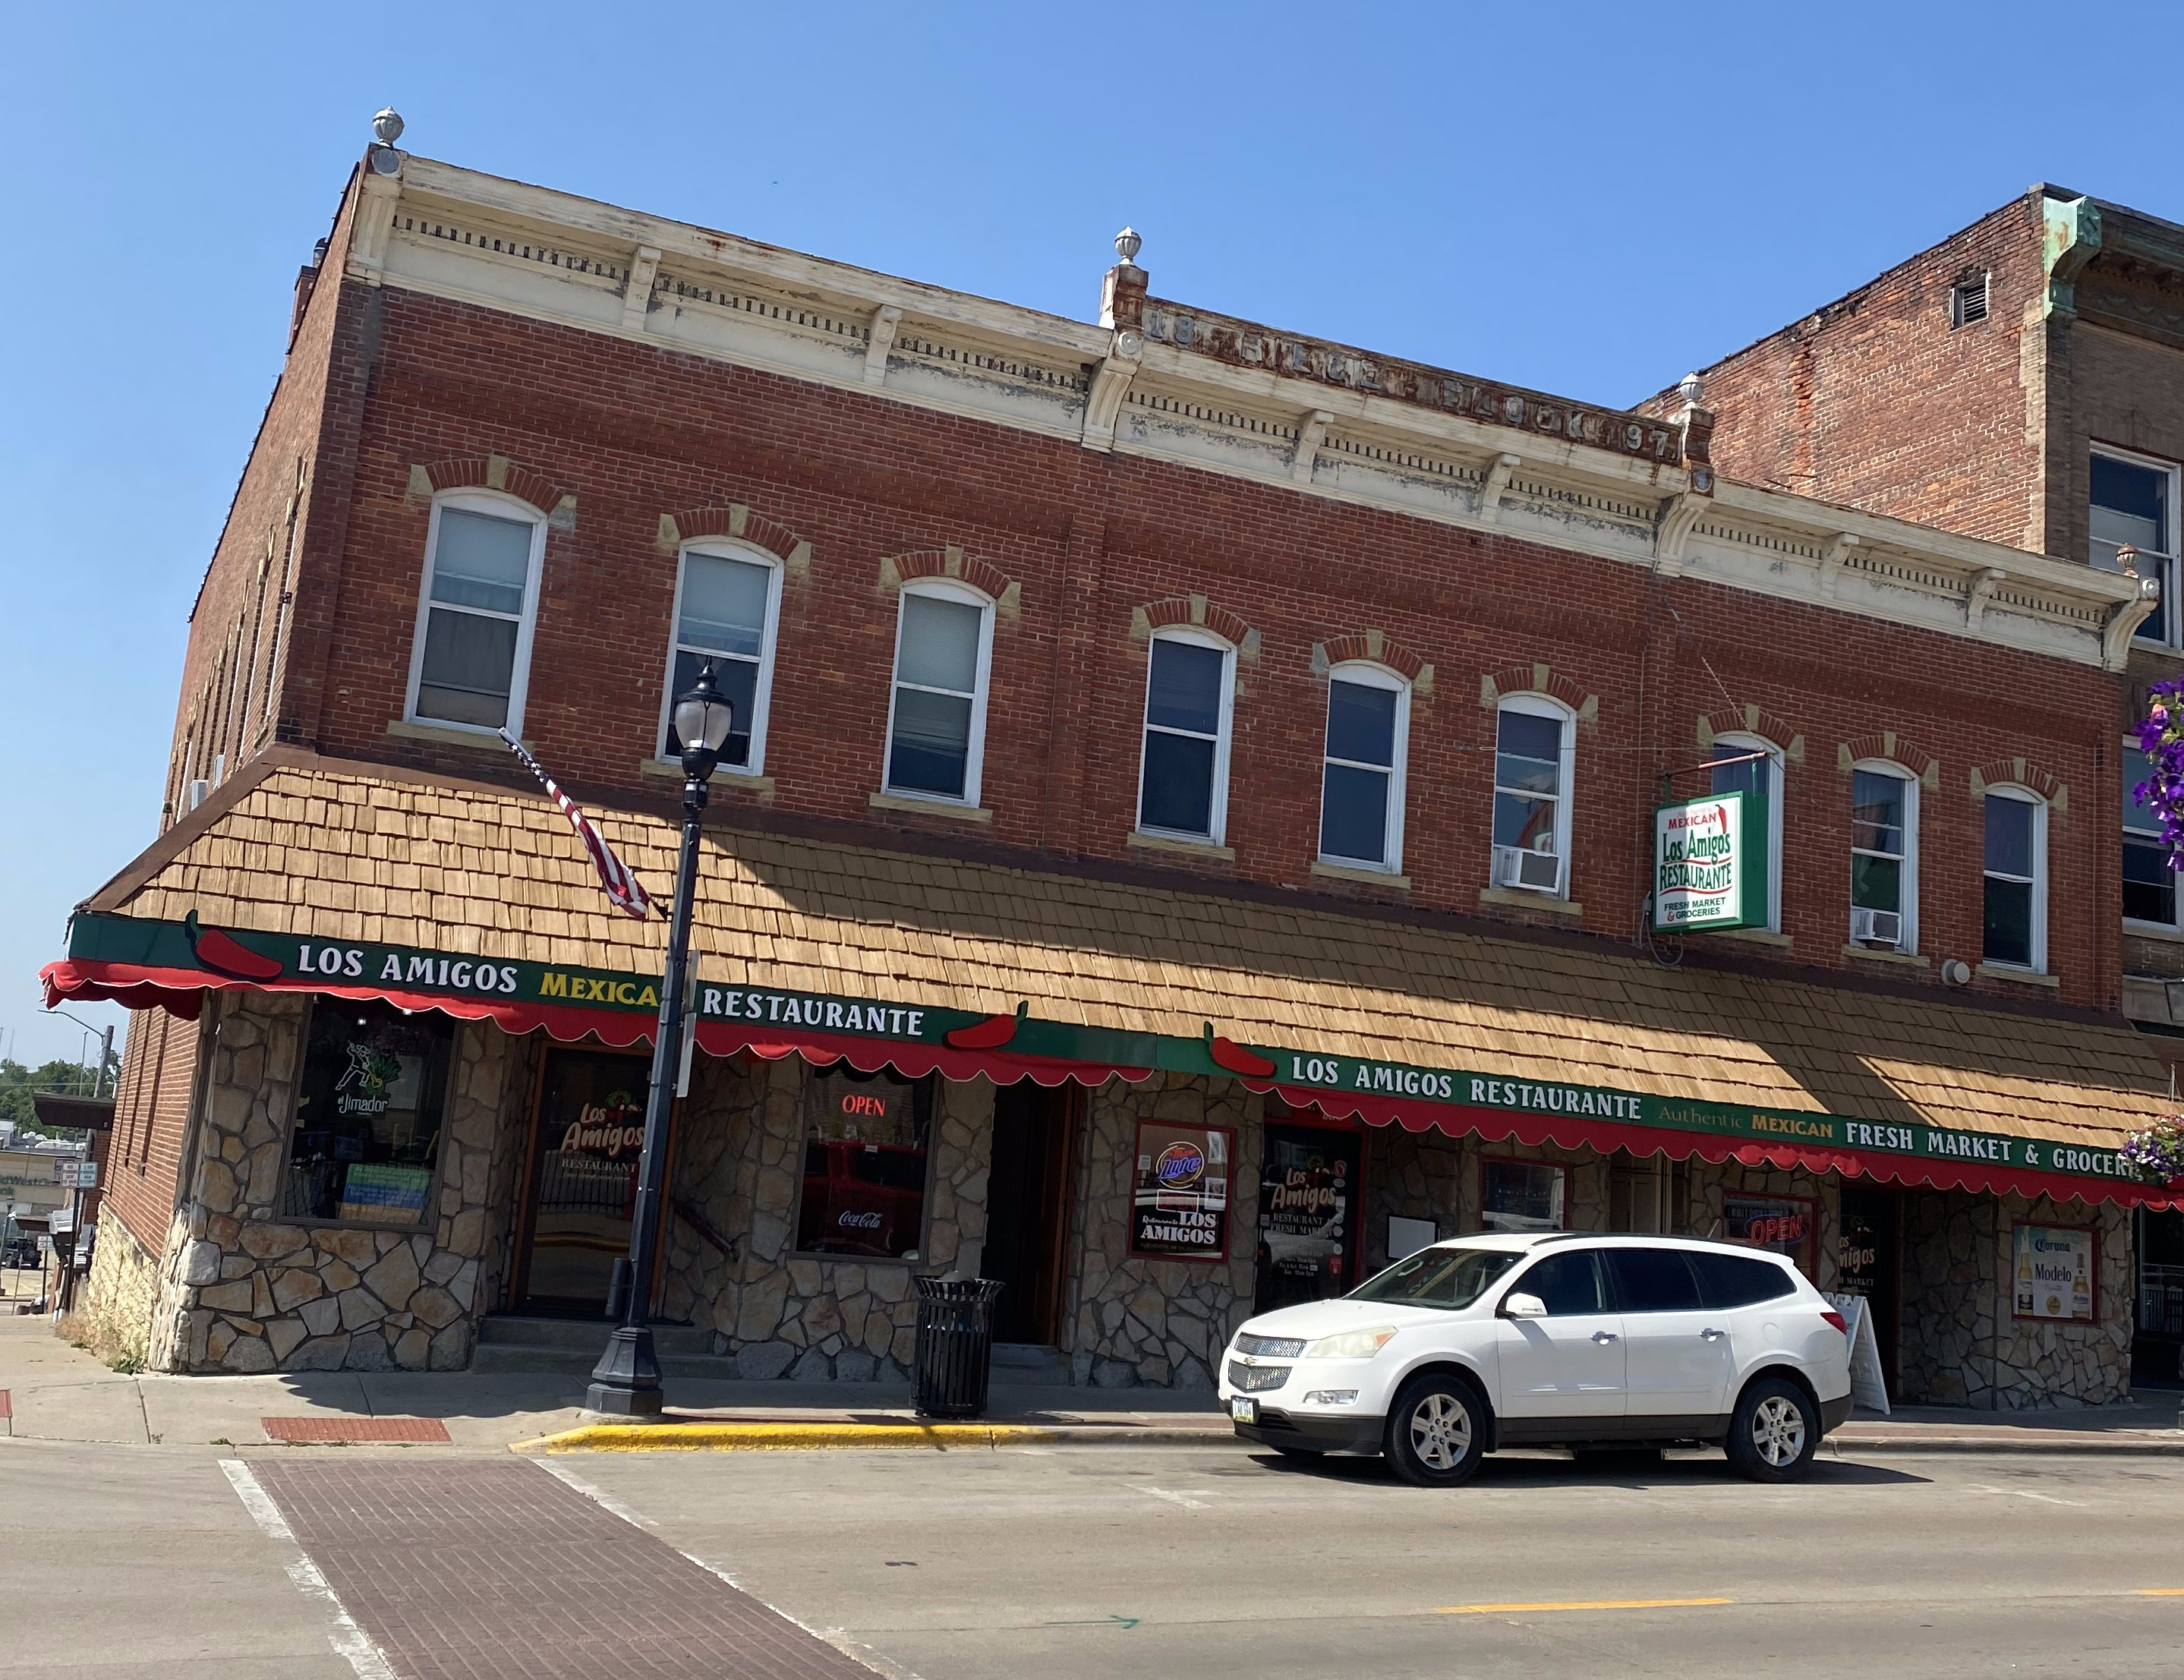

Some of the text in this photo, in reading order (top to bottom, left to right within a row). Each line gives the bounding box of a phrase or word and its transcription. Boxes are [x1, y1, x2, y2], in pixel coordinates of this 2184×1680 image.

[1668, 812, 1716, 830] MEXICAN
[1662, 827, 1731, 865] Los Amigos
[1659, 862, 1732, 892] RESTAURANTE
[1665, 897, 1726, 912] FRESH MARKET
[1667, 907, 1721, 922] & GROCERIES
[298, 944, 926, 1037] LOS AMIGOS MEXICA RESTAURANTE
[339, 1093, 388, 1114] Jimador
[580, 1103, 607, 1124] Los
[842, 1095, 886, 1117] OPEN
[1292, 1055, 1340, 1085] LOS
[1354, 1064, 1453, 1098] AMIGOS
[1470, 1078, 1643, 1121] RESTAURANTE
[1751, 1114, 1833, 1139] MEXICAN
[1846, 1122, 1915, 1151] FRESH
[1927, 1131, 2012, 1162] MARKET
[2025, 1143, 2040, 1165] &
[560, 1121, 644, 1156] Amigos
[562, 1158, 637, 1173] RESTAURANT
[1286, 1167, 1306, 1186] Los
[1271, 1184, 1336, 1214] Amigos
[1179, 1212, 1216, 1228] LOS
[1273, 1212, 1324, 1226] RESTAURANT
[1139, 1224, 1216, 1244] AMIGOS
[1751, 1215, 1803, 1246] OPEN
[2035, 1237, 2071, 1254] Corona
[2035, 1262, 2072, 1282] Modelo
